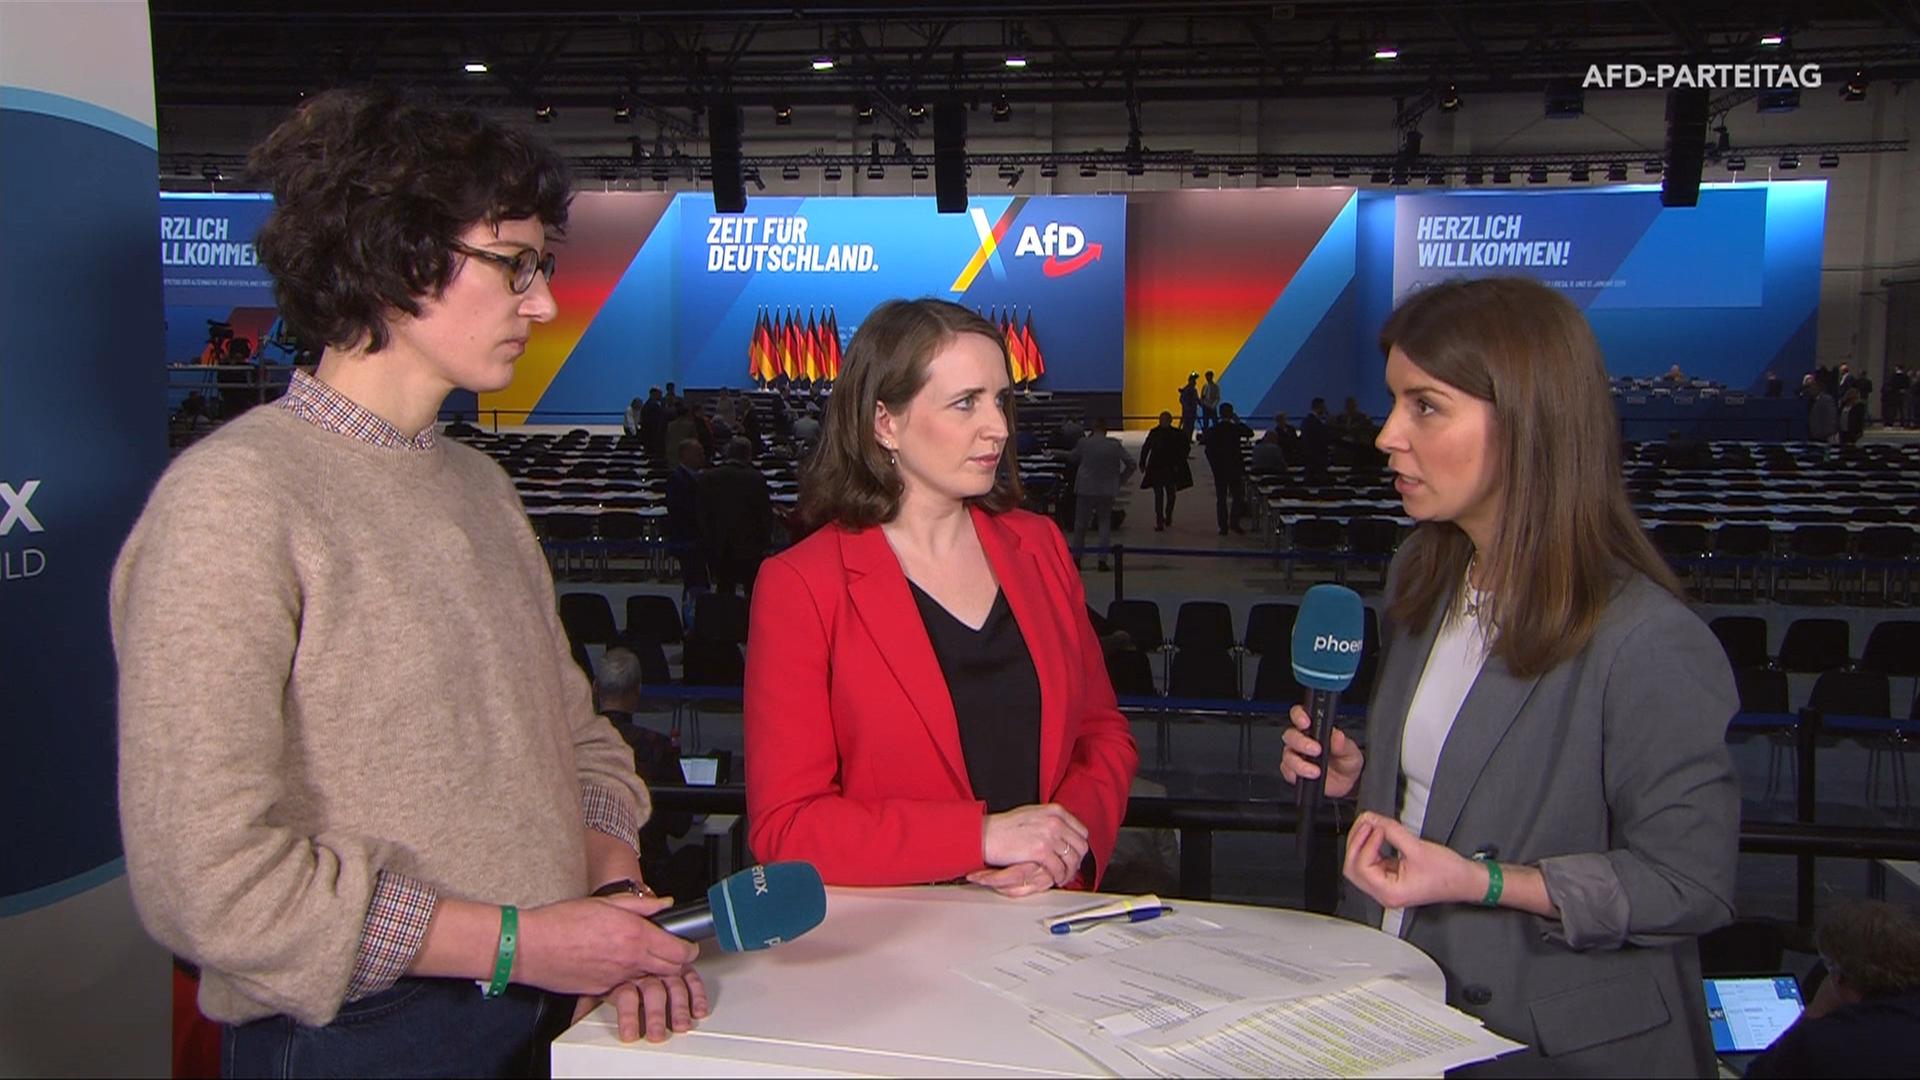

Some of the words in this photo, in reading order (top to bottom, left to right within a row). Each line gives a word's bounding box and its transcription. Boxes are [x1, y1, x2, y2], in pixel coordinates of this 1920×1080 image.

[706, 217, 758, 244] ZEIT
[762, 217, 808, 244] FÜR
[1015, 222, 1085, 256] AfD
[1417, 215, 1522, 240] HERZLICH
[707, 244, 880, 272] DEUTSCHLAND.
[1418, 241, 1571, 267] WILLKOMMEN!
